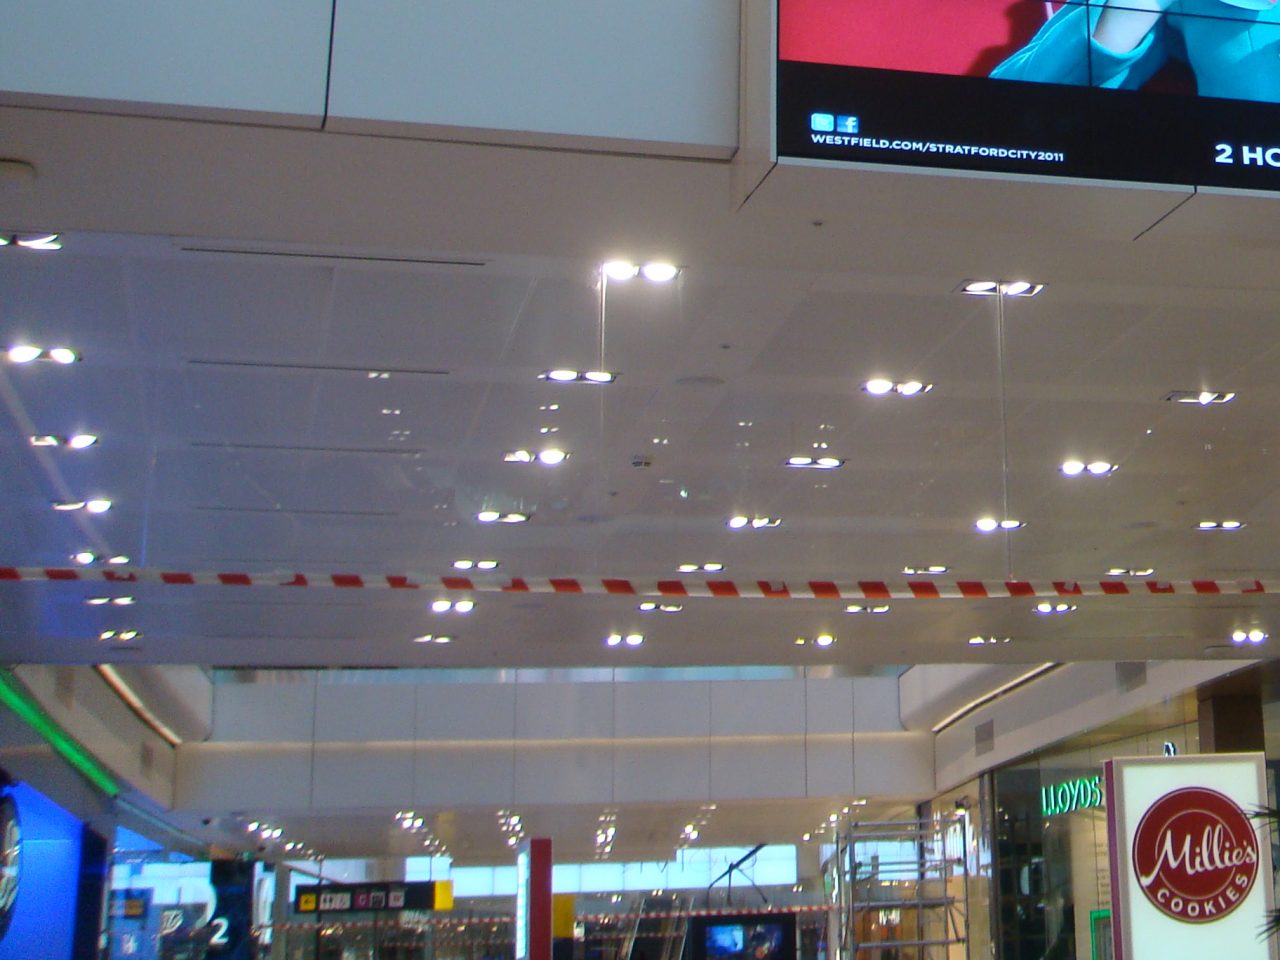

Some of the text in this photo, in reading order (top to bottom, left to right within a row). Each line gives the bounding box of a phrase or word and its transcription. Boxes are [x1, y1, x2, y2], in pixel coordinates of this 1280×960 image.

[811, 134, 1065, 162] WESTFIELD.COM/STRATFORDCITY2011
[1215, 144, 1233, 164] 2
[1041, 776, 1103, 816] LLOYDS
[1140, 824, 1258, 887] Millie's
[1157, 872, 1249, 917] COOKIES
